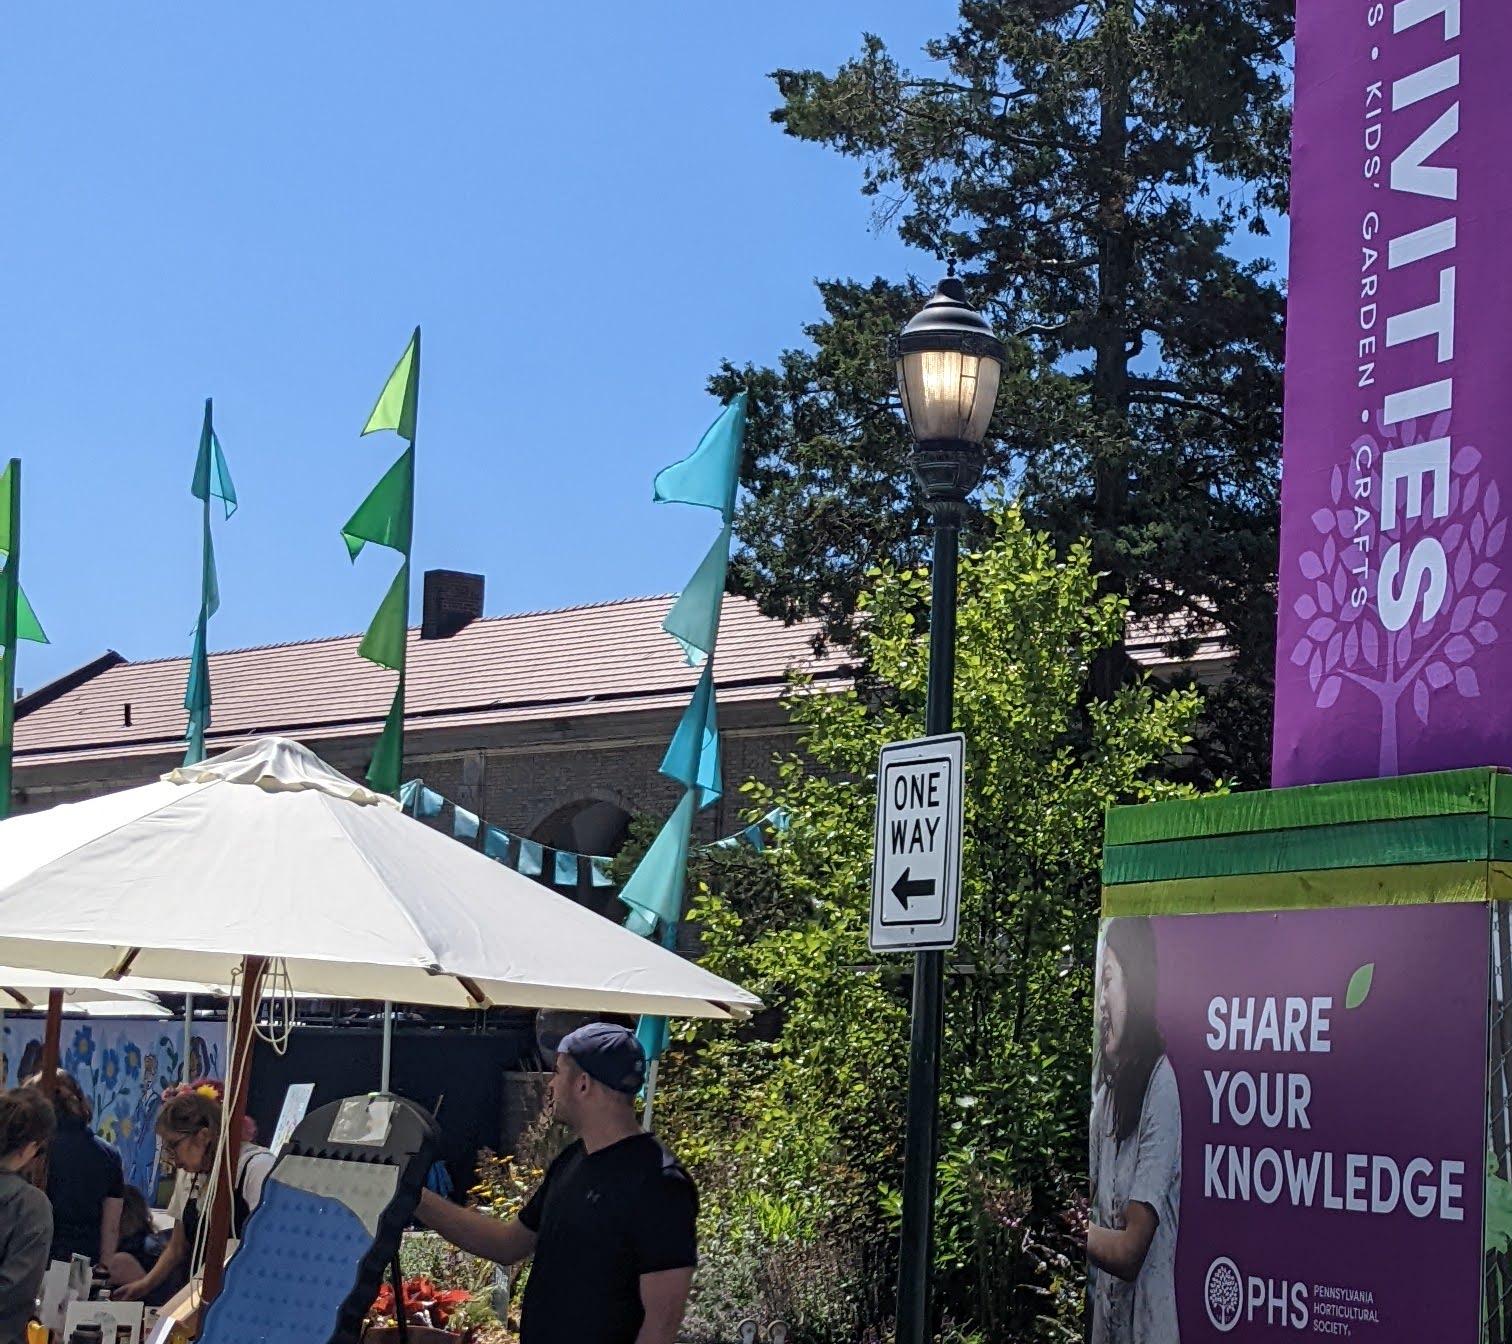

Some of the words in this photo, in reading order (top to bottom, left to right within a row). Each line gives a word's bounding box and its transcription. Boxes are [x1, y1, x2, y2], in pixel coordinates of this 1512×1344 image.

[1363, 81, 1383, 190] KIDS'
[1358, 211, 1379, 388] GARDEN
[1351, 444, 1374, 609] CRAFTS
[894, 771, 941, 811] ONE
[891, 816, 941, 855] WAY
[1206, 996, 1333, 1053] SHARE
[1203, 1069, 1312, 1130] YOUR
[1203, 1143, 1466, 1222] KNOWLEDGE
[1247, 1275, 1309, 1330] PHS
[1313, 1284, 1374, 1304] PENNSYLVANIA
[1313, 1302, 1380, 1323] HORTICULTURAL
